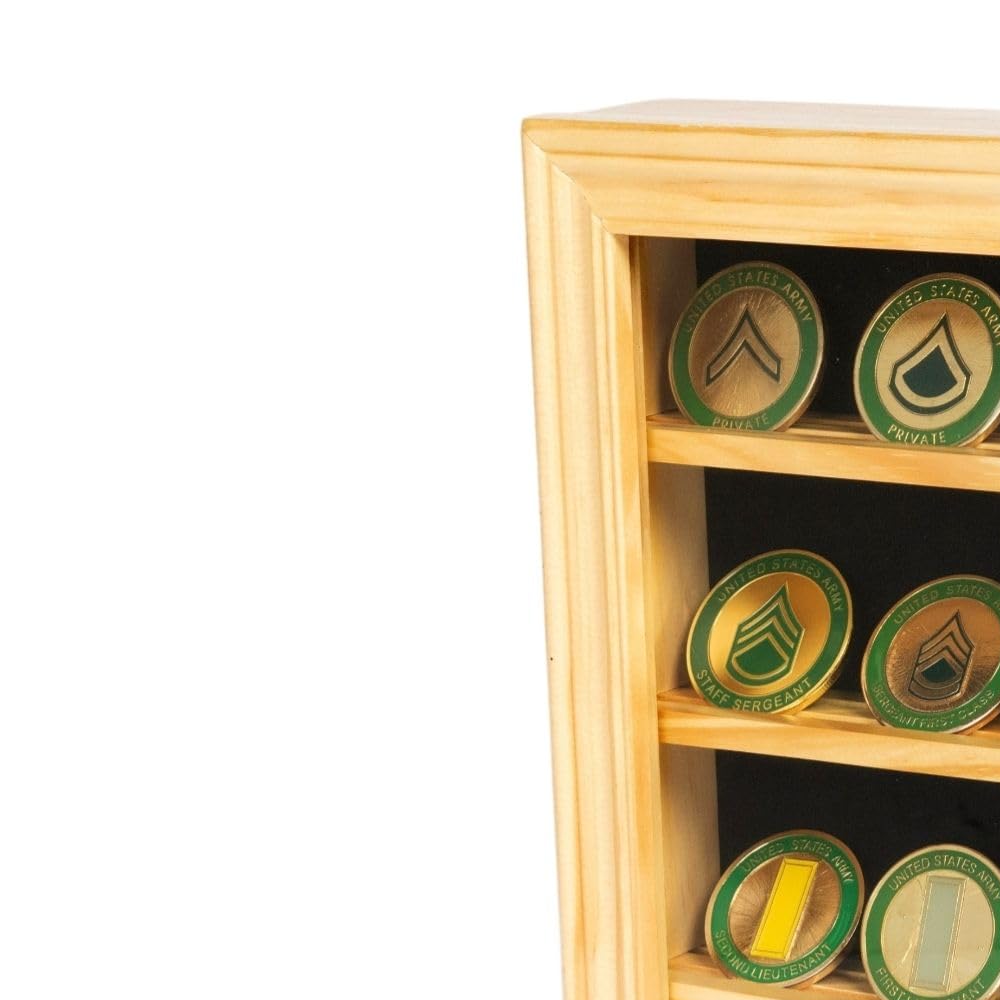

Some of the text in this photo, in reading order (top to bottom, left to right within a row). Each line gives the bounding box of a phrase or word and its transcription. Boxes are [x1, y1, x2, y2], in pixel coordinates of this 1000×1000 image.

[728, 270, 779, 287] STATES
[781, 283, 813, 321] ARMY
[877, 291, 923, 334] UNITED
[931, 284, 980, 305] STATES
[712, 413, 770, 429] PRIVATE
[888, 424, 947, 445] PRIVATE
[719, 558, 844, 612] UNITED STATES ARMY
[894, 590, 940, 624] UNITED
[946, 584, 993, 599] STATES
[697, 669, 811, 711] STAFF SERGEANT
[742, 840, 854, 884] UNITED STATES ARMY
[889, 858, 931, 891] UNITED
[934, 855, 977, 873] STATES
[715, 930, 831, 980] SECOND LIEUTENANT
[876, 968, 906, 1000] FIRST
